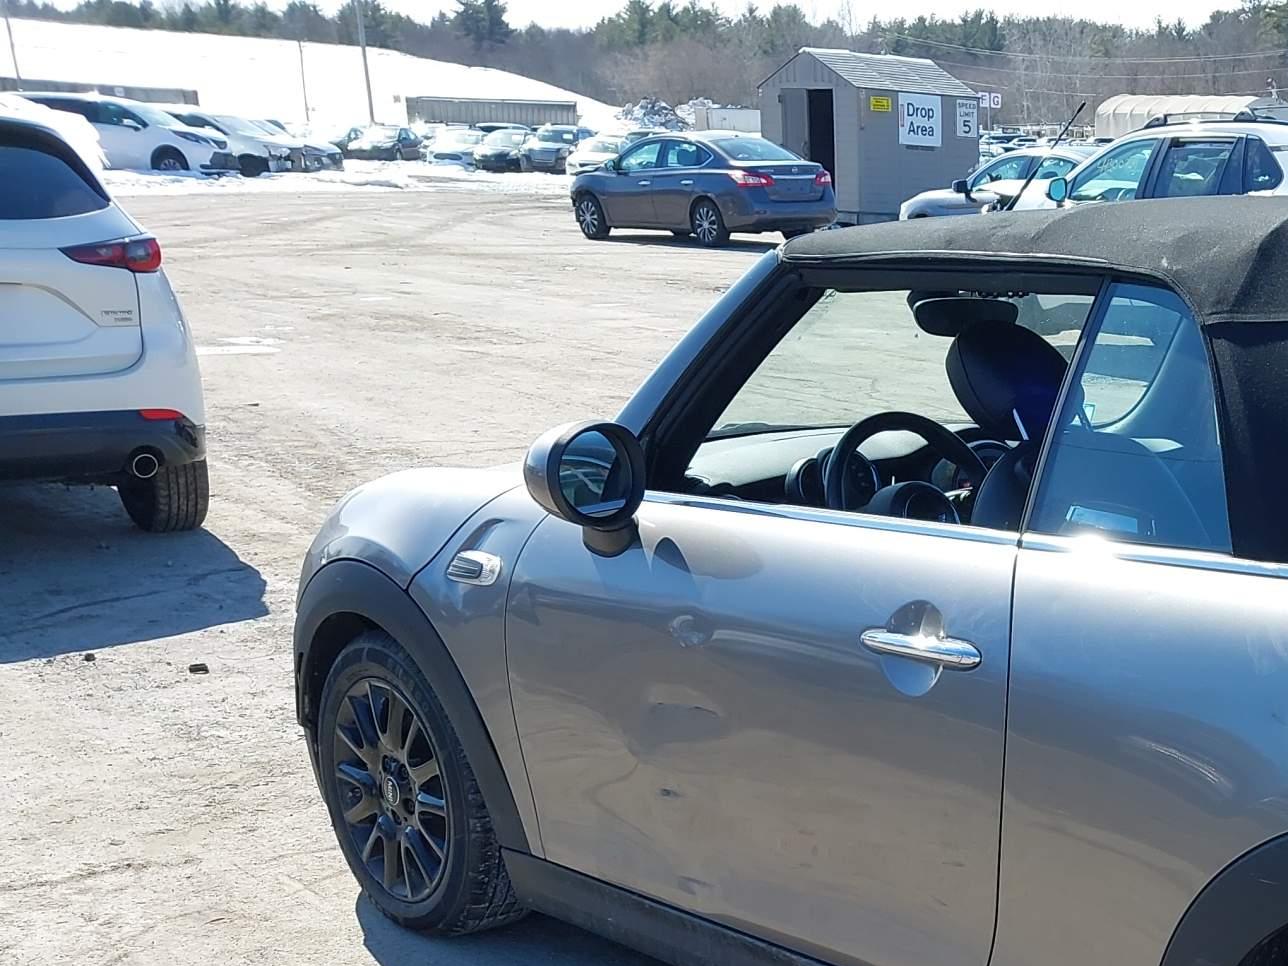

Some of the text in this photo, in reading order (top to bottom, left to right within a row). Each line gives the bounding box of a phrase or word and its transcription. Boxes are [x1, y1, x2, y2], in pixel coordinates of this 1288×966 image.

[958, 102, 976, 110] SPEED
[993, 95, 1000, 106] G
[906, 102, 934, 121] Drop
[907, 121, 934, 137] Area
[962, 120, 972, 134] 5
